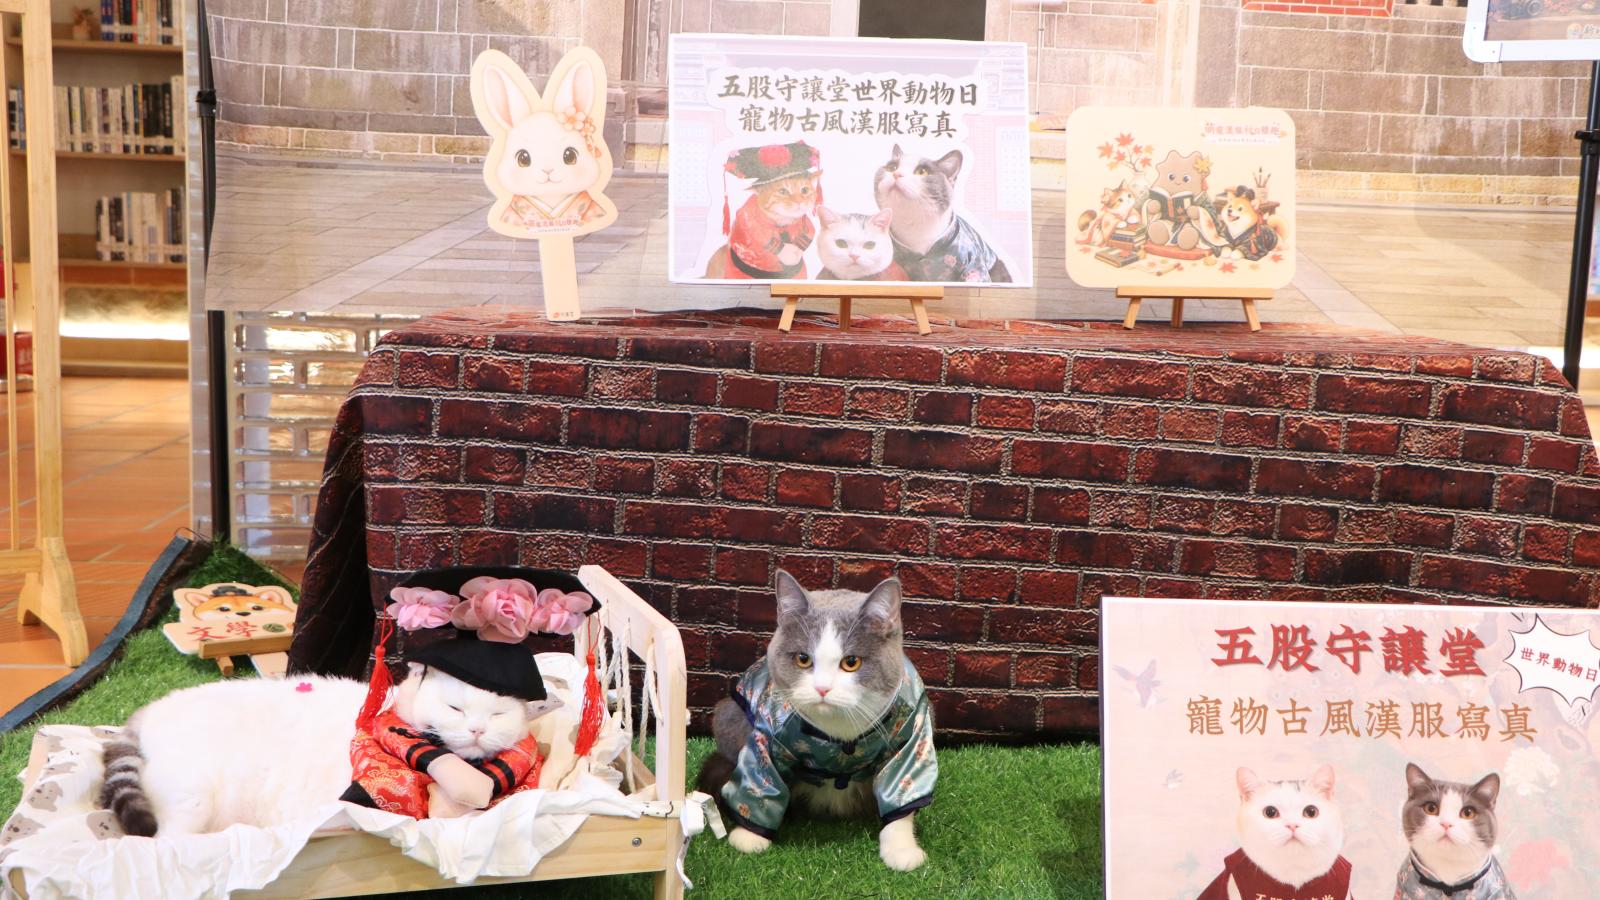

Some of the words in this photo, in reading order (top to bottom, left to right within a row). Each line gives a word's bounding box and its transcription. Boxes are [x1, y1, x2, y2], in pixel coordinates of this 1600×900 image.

[718, 75, 978, 106] 五股守讓堂世界動物日
[739, 104, 957, 138] 寵物古風漢服寫真
[1211, 624, 1488, 677] 五股守讓堂
[1520, 648, 1598, 682] 世界動物日
[1187, 696, 1538, 742] 寵物古風漢服寫真
